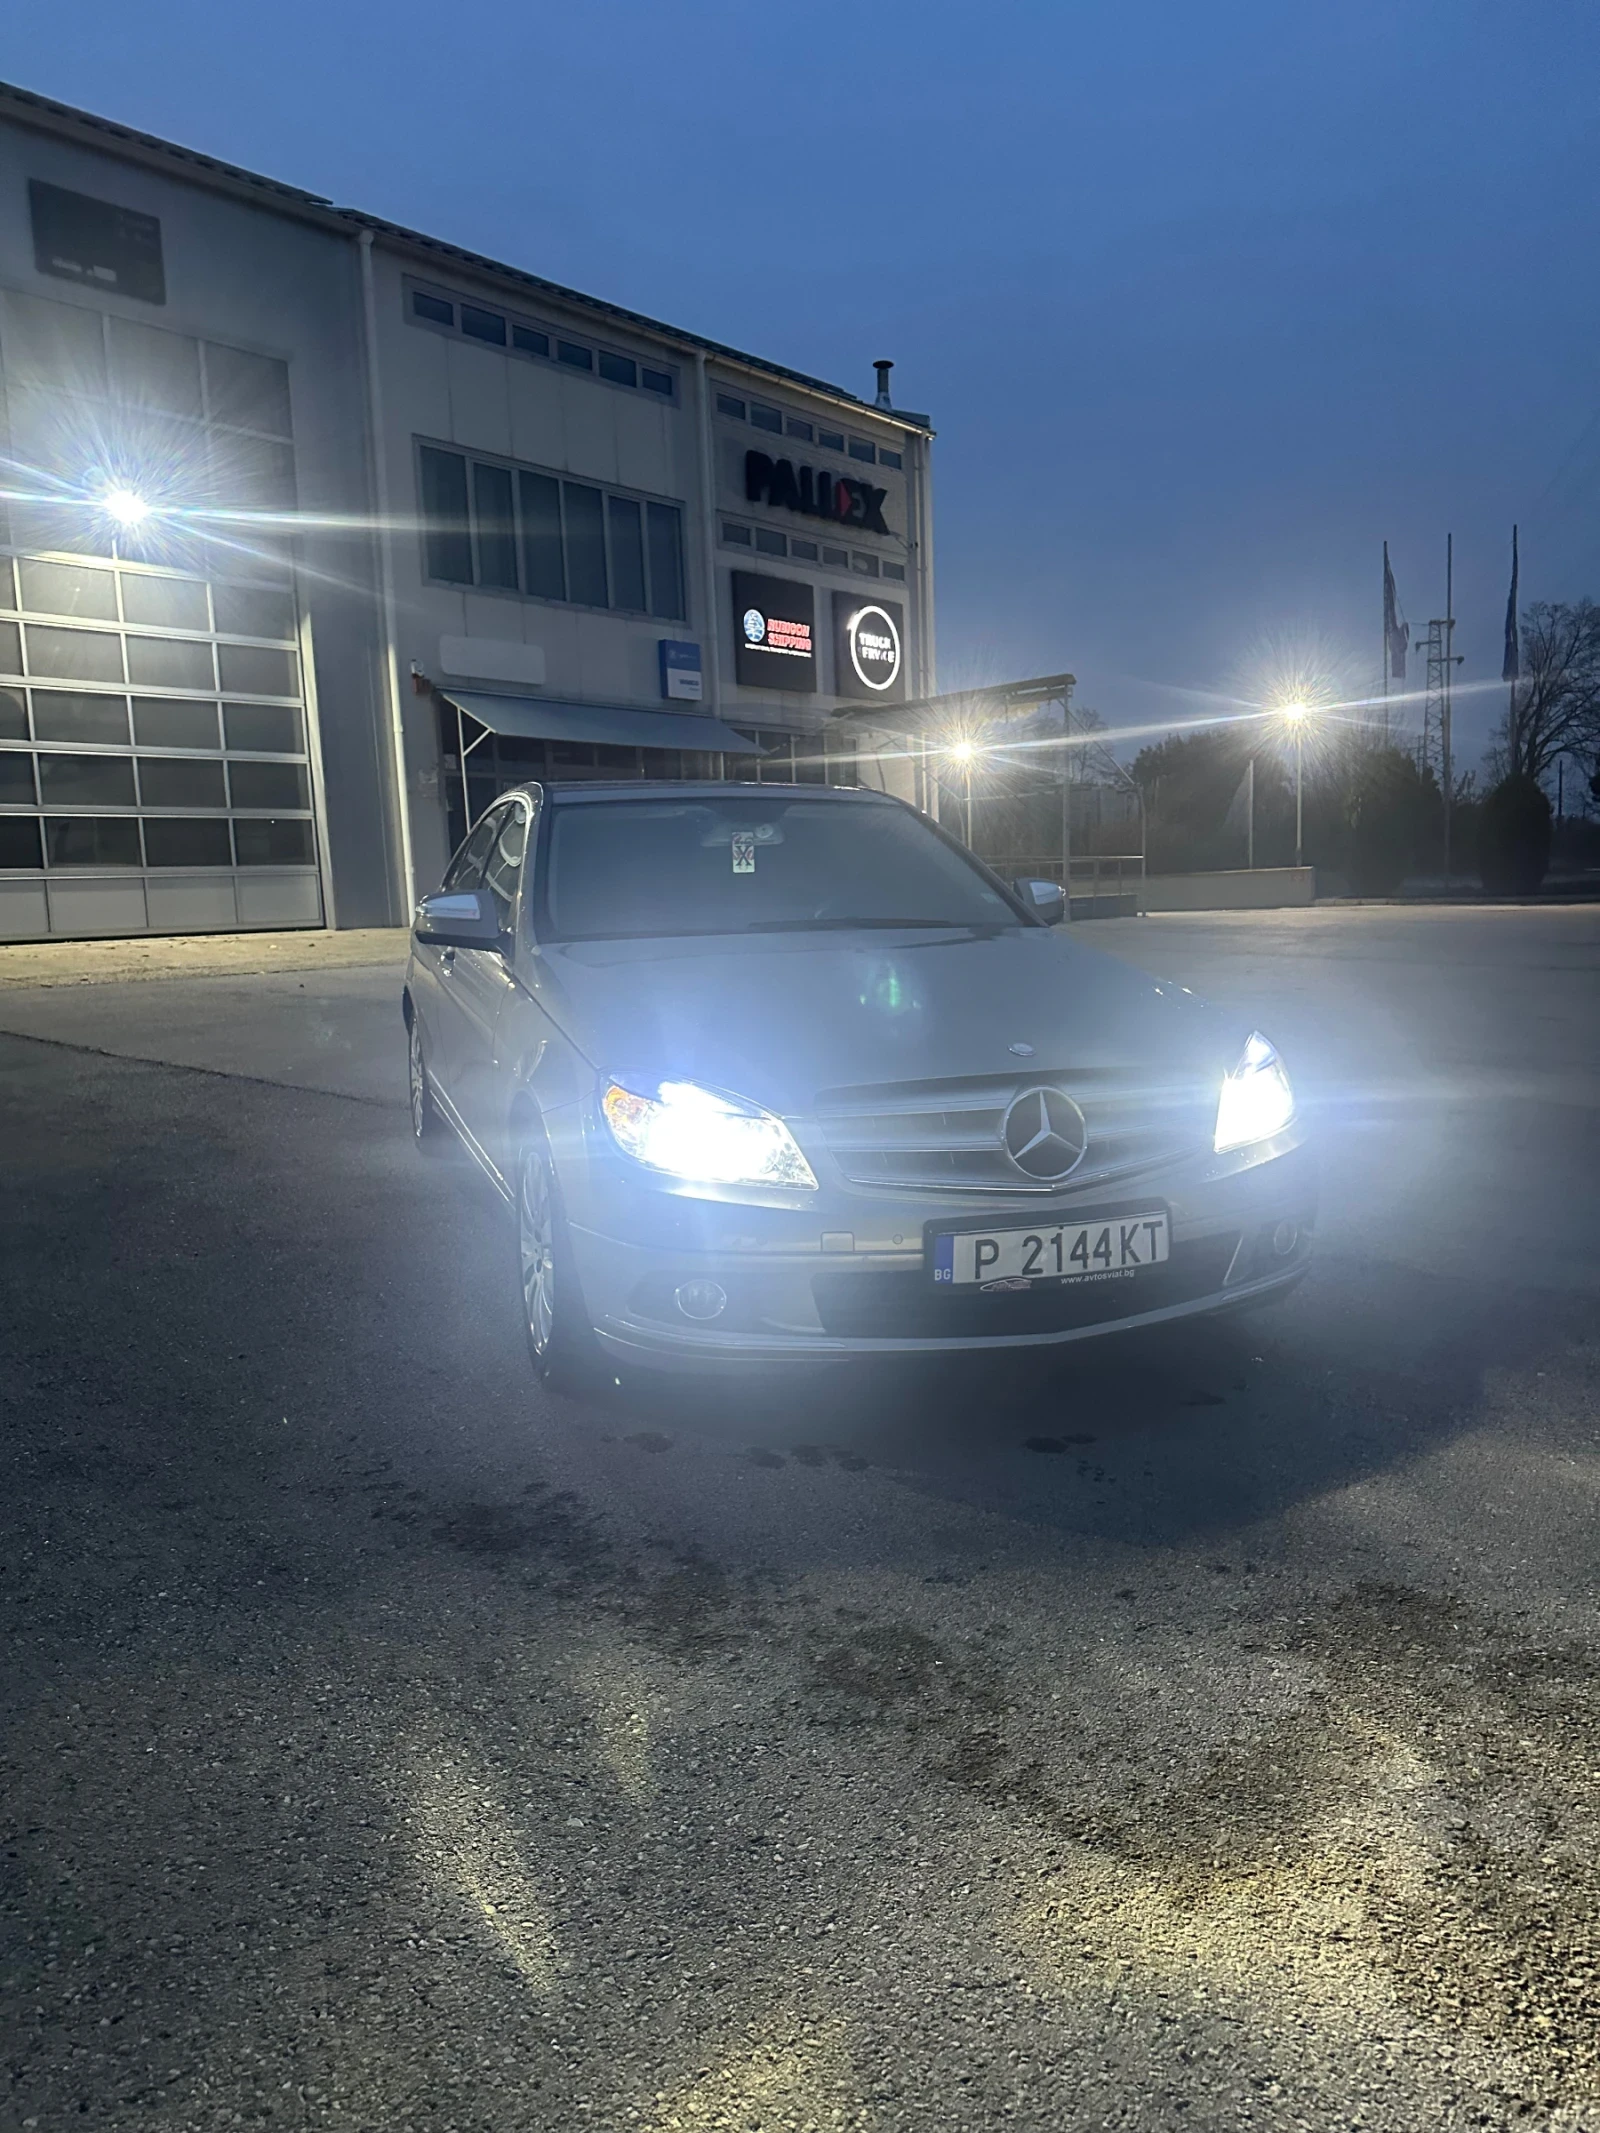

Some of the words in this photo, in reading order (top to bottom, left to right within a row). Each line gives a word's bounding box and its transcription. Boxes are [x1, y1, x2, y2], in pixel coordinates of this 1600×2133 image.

[767, 618, 810, 637] RUBICON
[768, 633, 812, 651] SHIPPING
[974, 1238, 1000, 1280] P
[934, 1268, 951, 1281] BG
[1060, 1268, 1135, 1285] www.avtosviat.bg
